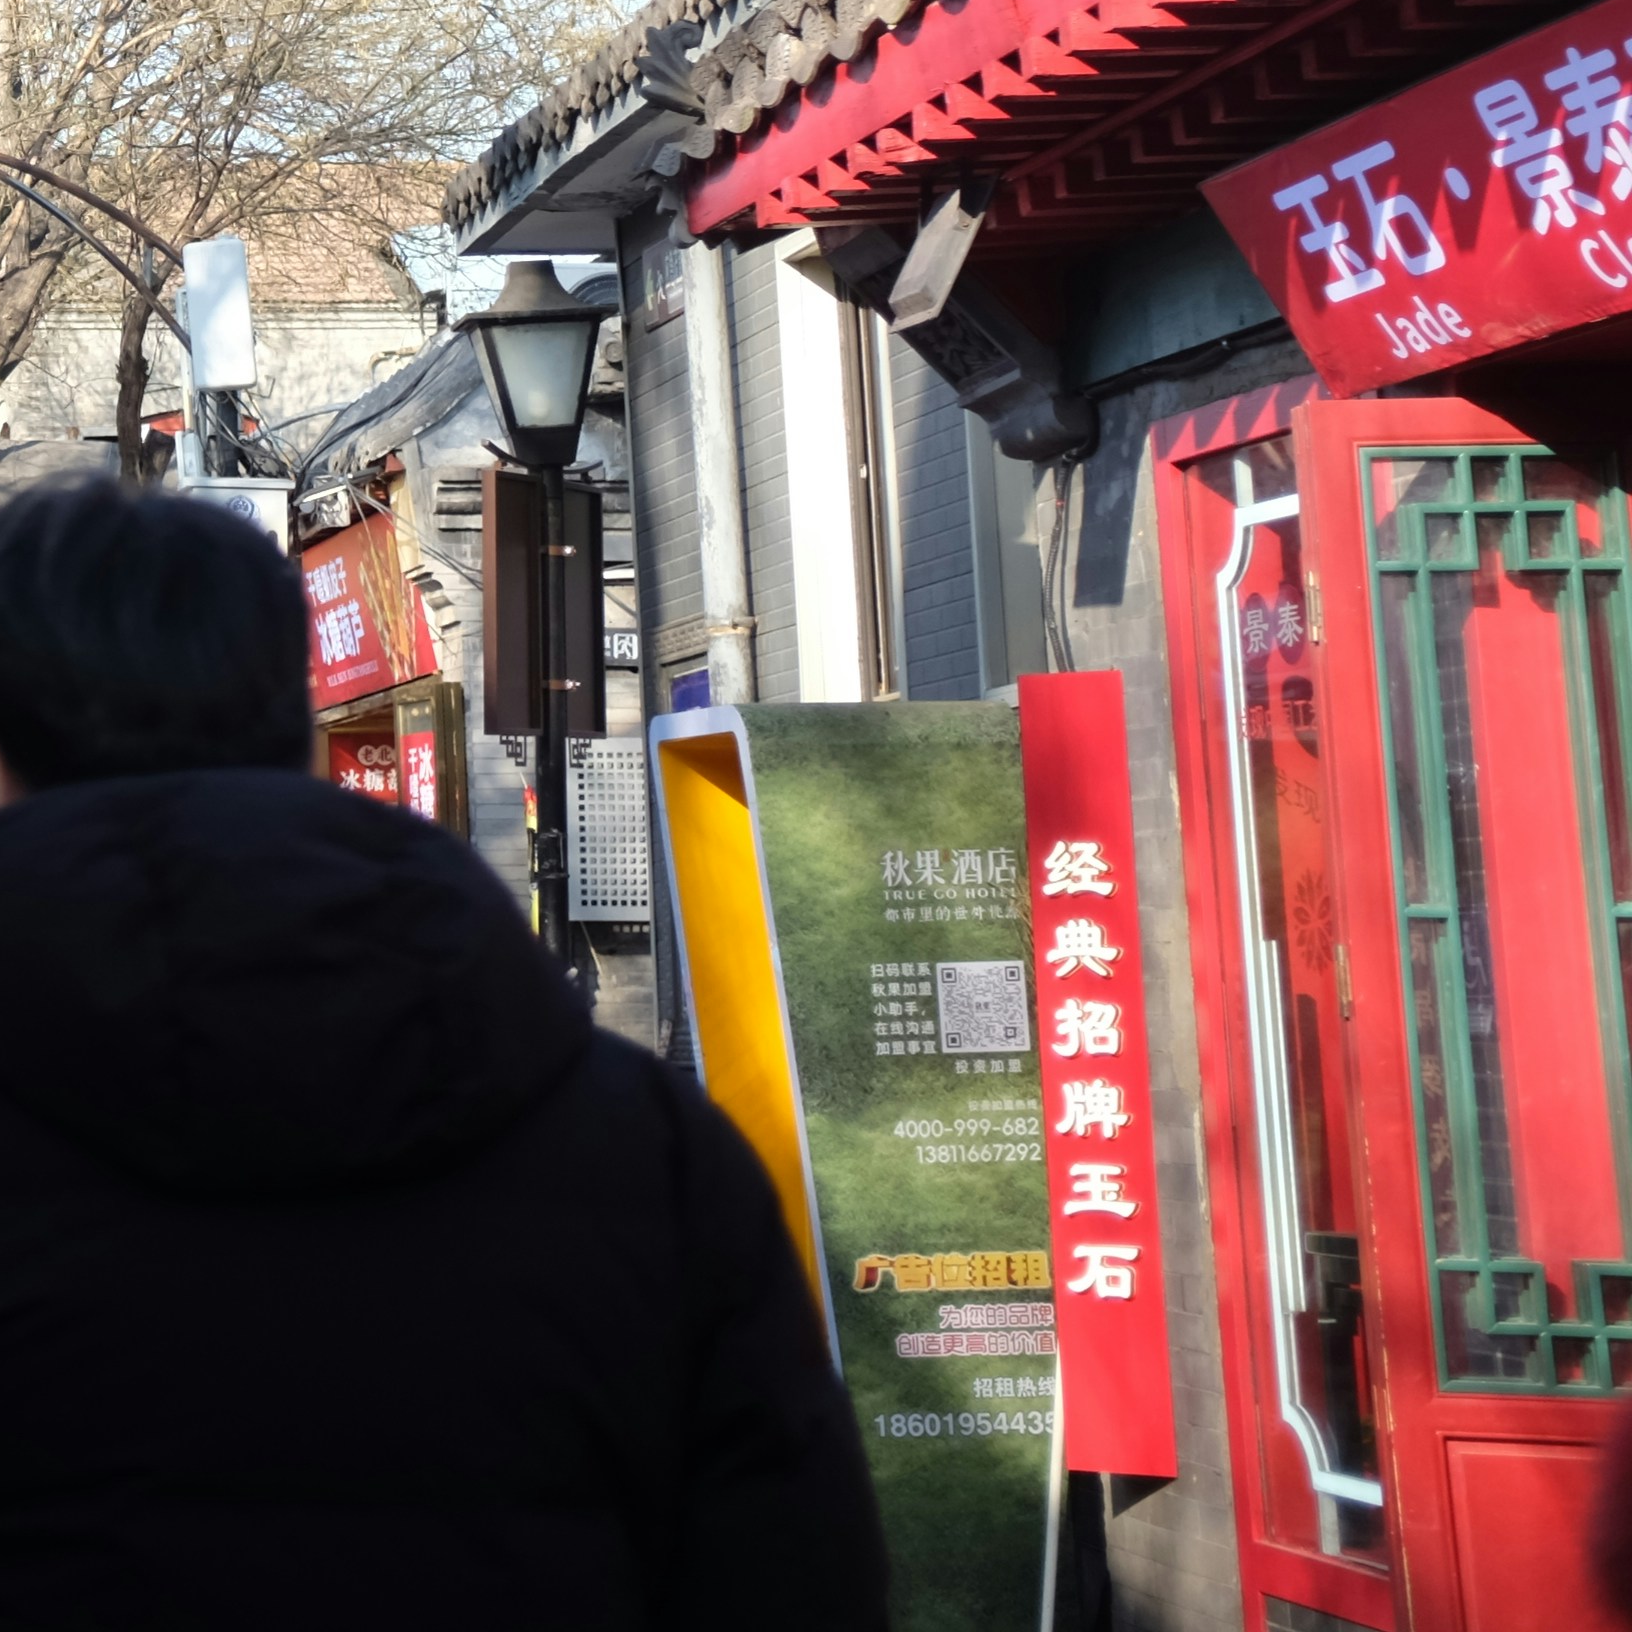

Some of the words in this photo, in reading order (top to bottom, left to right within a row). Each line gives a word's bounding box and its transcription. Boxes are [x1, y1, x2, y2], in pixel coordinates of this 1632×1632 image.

[1273, 38, 1632, 303] 玉石·景泰
[1375, 296, 1472, 359] Jade
[315, 598, 365, 666] 冰糖葫芦
[1242, 601, 1305, 654] 景泰
[879, 848, 1017, 887] 秋果酒店
[884, 889, 927, 901] TRUE
[870, 962, 932, 978] 扫码联系
[871, 982, 933, 997] 秋果加盟
[874, 1020, 935, 1036] 在线沟通
[876, 1040, 937, 1056] 加盟事宜
[954, 1059, 1023, 1074] 投资加盟
[1041, 840, 1141, 1302] 经典招牌玉石
[893, 1117, 1040, 1139] 4000-999-682
[916, 1142, 1042, 1164] 13811667292
[853, 1251, 1052, 1292] 广告位招租
[939, 1303, 1054, 1328] 为您的品牌
[895, 1330, 1056, 1357] 创造更高的价值
[973, 1376, 1056, 1398] 招租热线
[874, 1410, 1055, 1438] 18601954435
